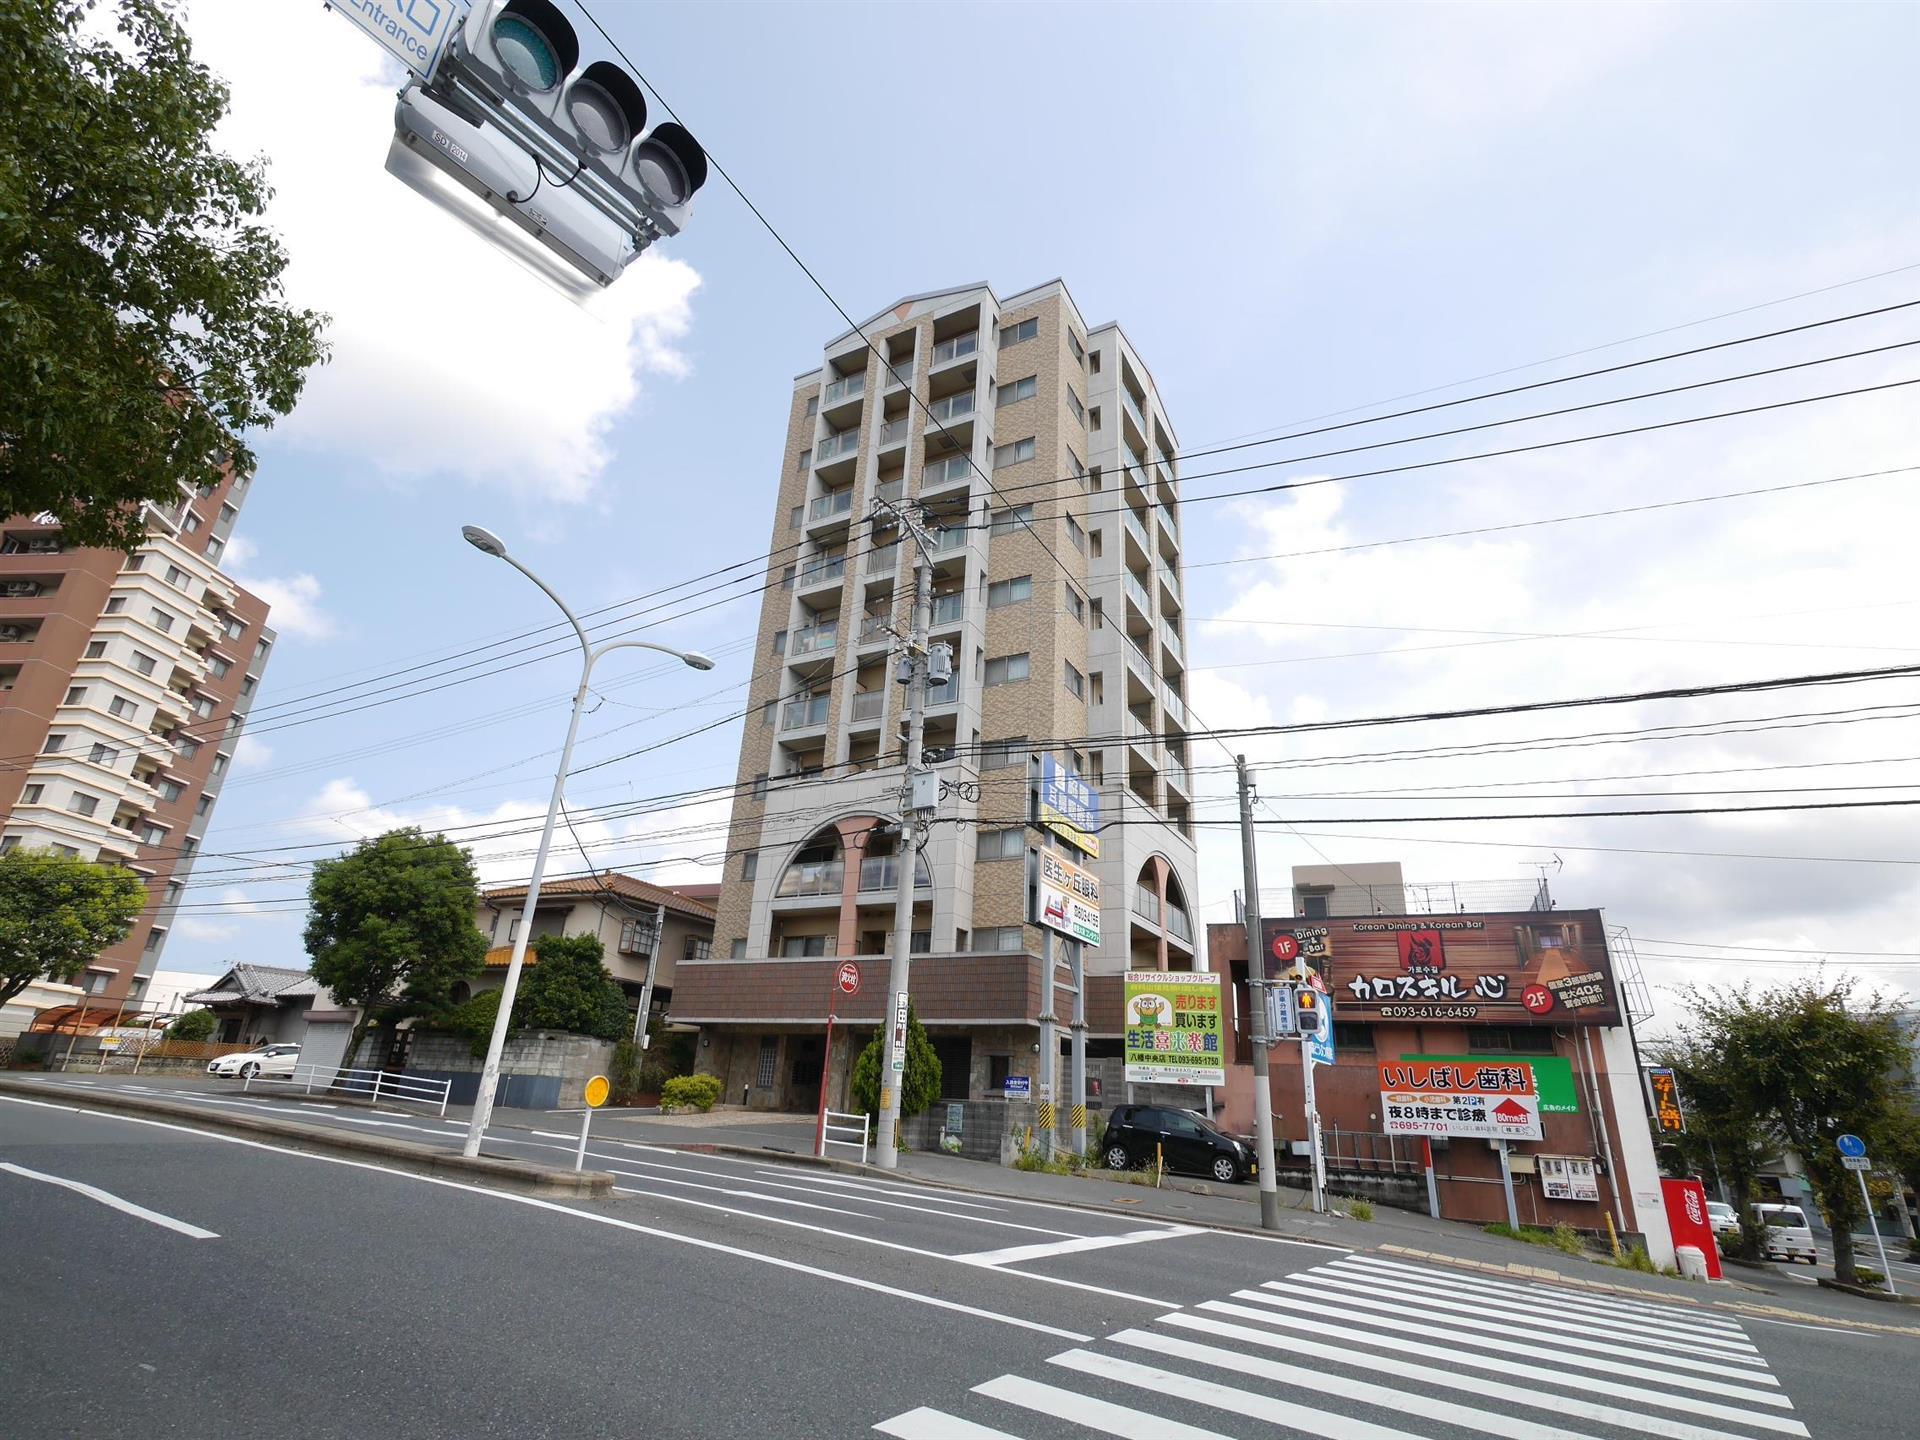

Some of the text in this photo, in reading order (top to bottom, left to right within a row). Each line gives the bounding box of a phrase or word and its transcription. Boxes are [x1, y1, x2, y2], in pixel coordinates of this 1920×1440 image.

[433, 133, 467, 162] SD 2014
[1353, 920, 1482, 931] Korean Dining & Korean Bar
[1296, 927, 1328, 940] Dining
[1278, 941, 1291, 955] 1F
[1308, 943, 1325, 953] Bar
[1408, 965, 1438, 974] 가로수길
[1127, 973, 1216, 983] 総合リサイクルショップグループ
[1348, 974, 1469, 1000] カロスキル
[1559, 984, 1603, 1000] 最大40名
[1175, 994, 1217, 1010] 売ります
[1527, 991, 1546, 1008] 2F
[1394, 1006, 1477, 1017] 093-616-6459
[1175, 1013, 1218, 1029] 買います
[1130, 1053, 1166, 1063] 八幡中央店
[1384, 1066, 1528, 1091] いしばし歯科
[1388, 1106, 1487, 1122] 夜8時まで診療
[1543, 1104, 1577, 1112] 広告のメイク
[1400, 1120, 1448, 1132] 695-7701
[1684, 1187, 1704, 1225] Coca-Cola
